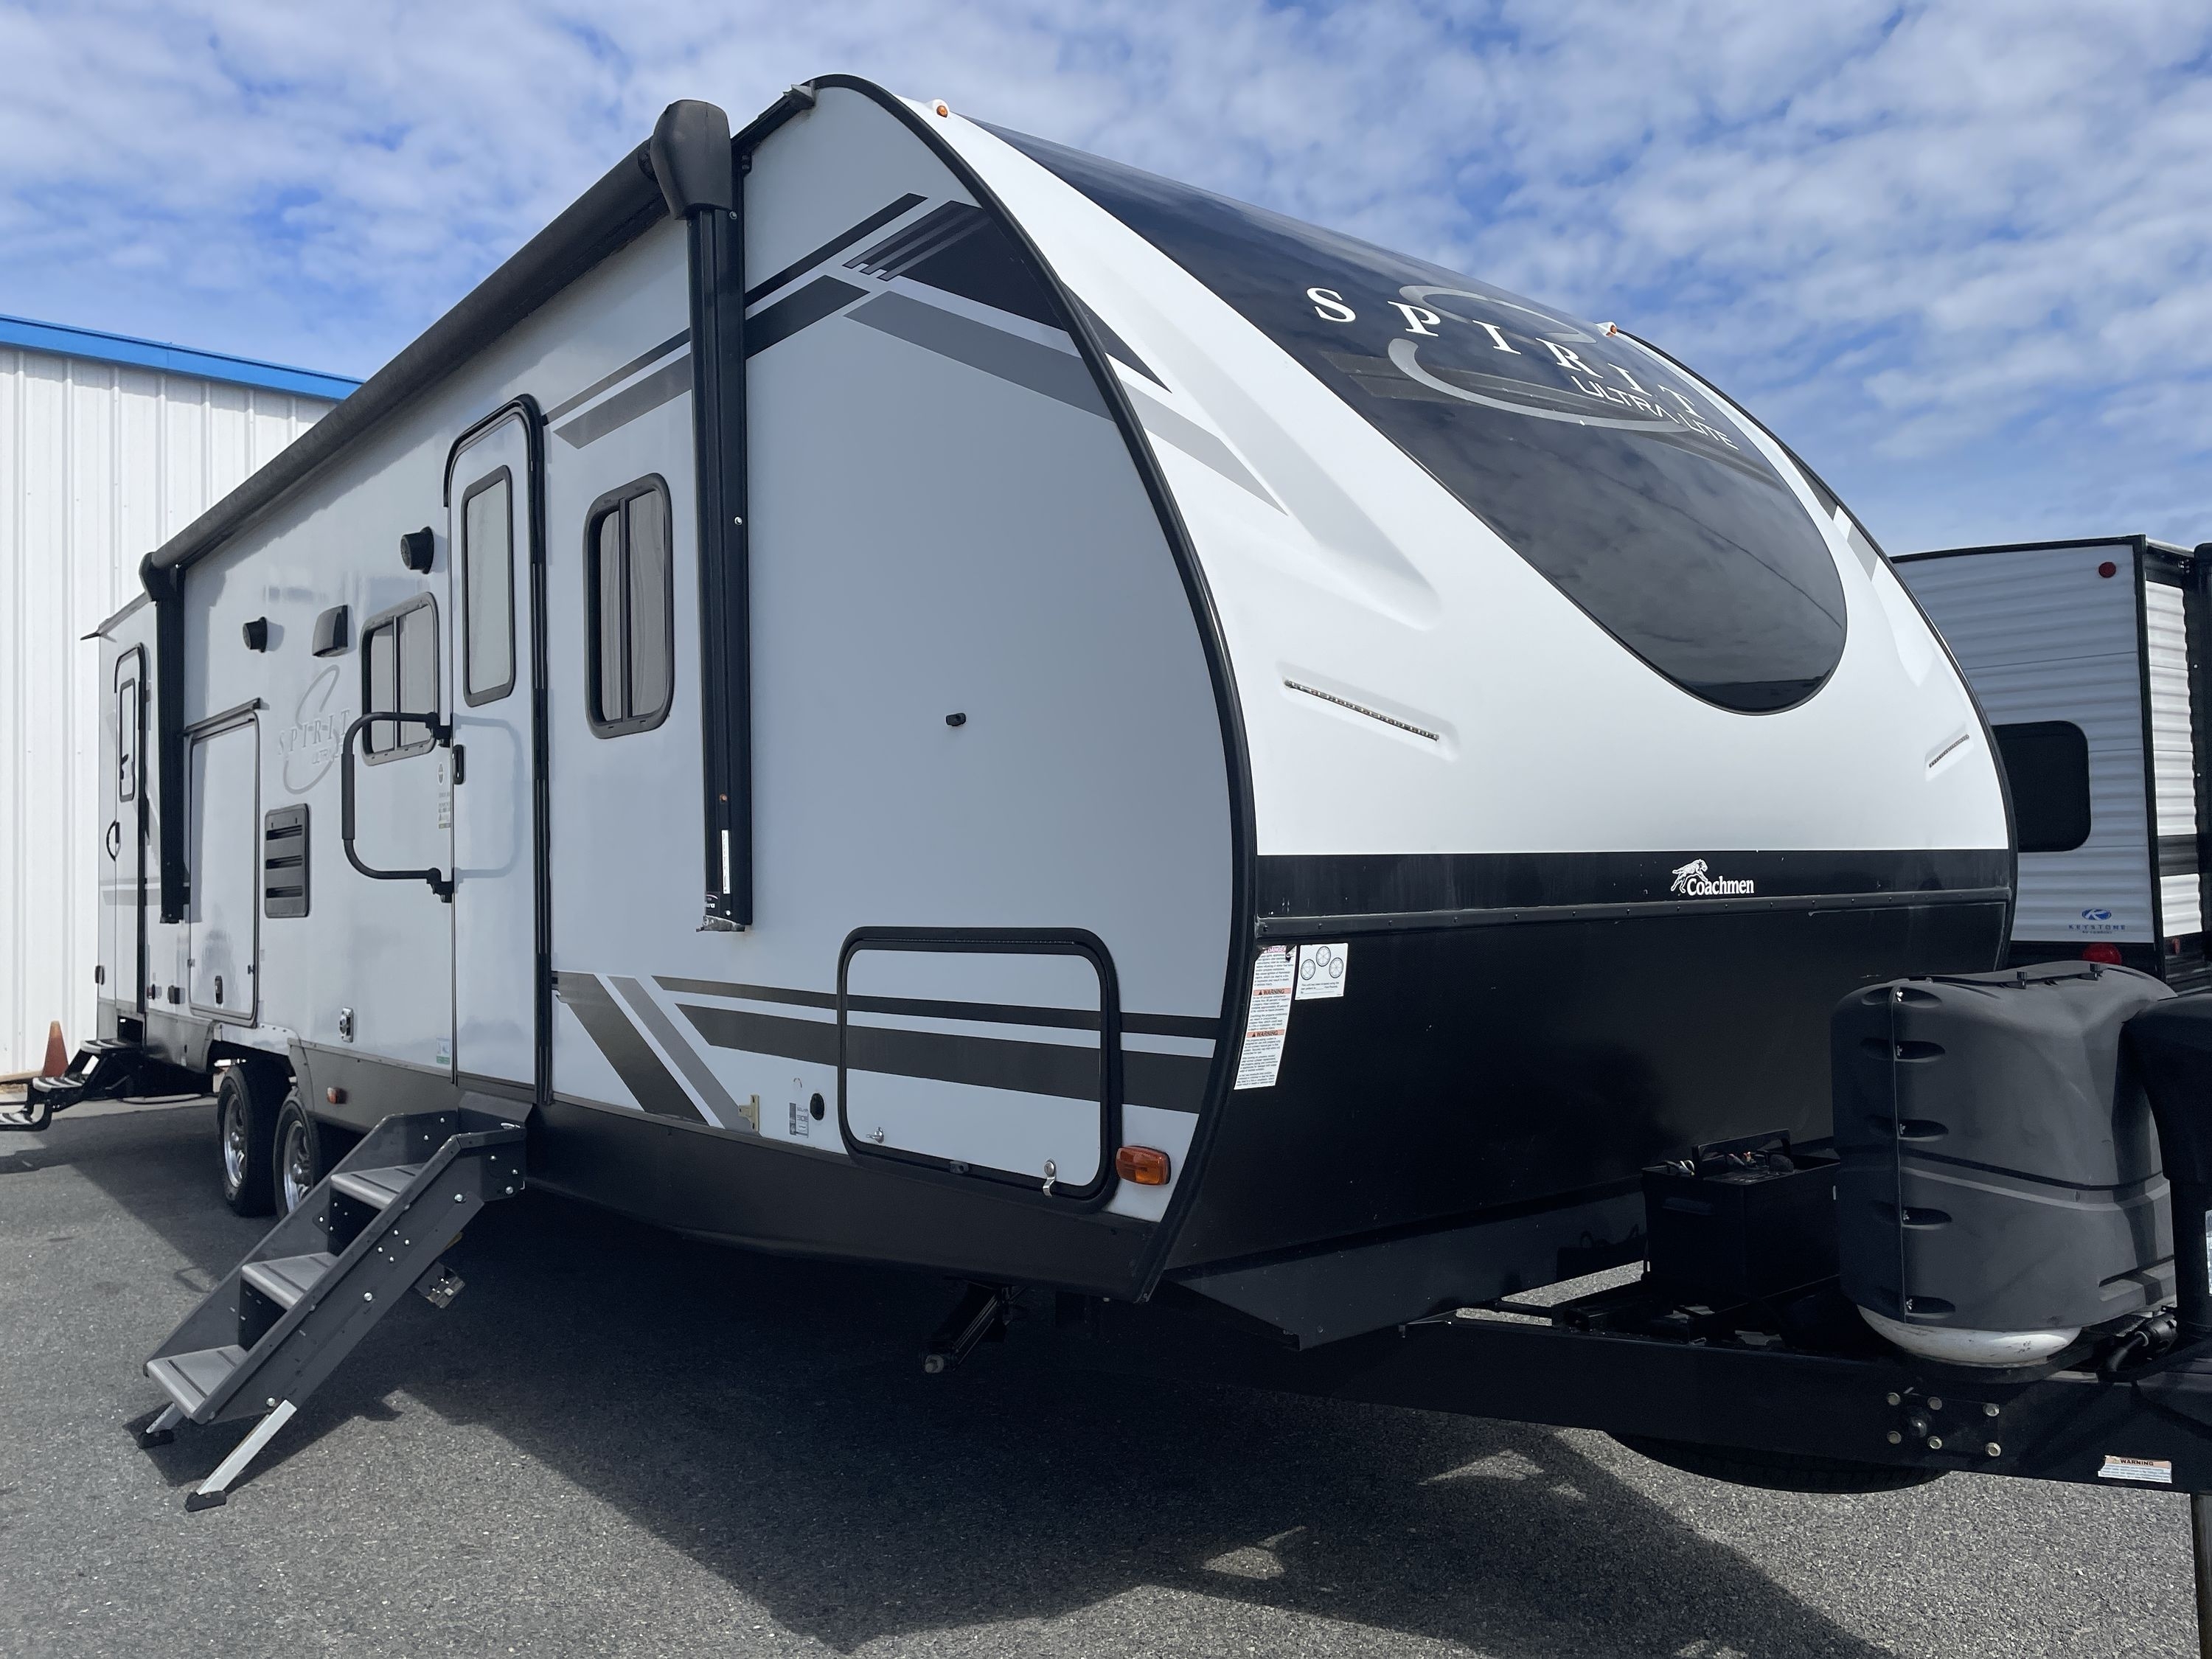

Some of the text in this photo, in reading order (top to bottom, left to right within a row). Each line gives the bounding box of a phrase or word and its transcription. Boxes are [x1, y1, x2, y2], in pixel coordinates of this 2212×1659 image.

[1307, 287, 1705, 420] SPIRIT
[1571, 375, 1739, 451] ULTRA LITE
[278, 709, 350, 755] SPIRIT
[1687, 875, 1754, 896] Coachmen
